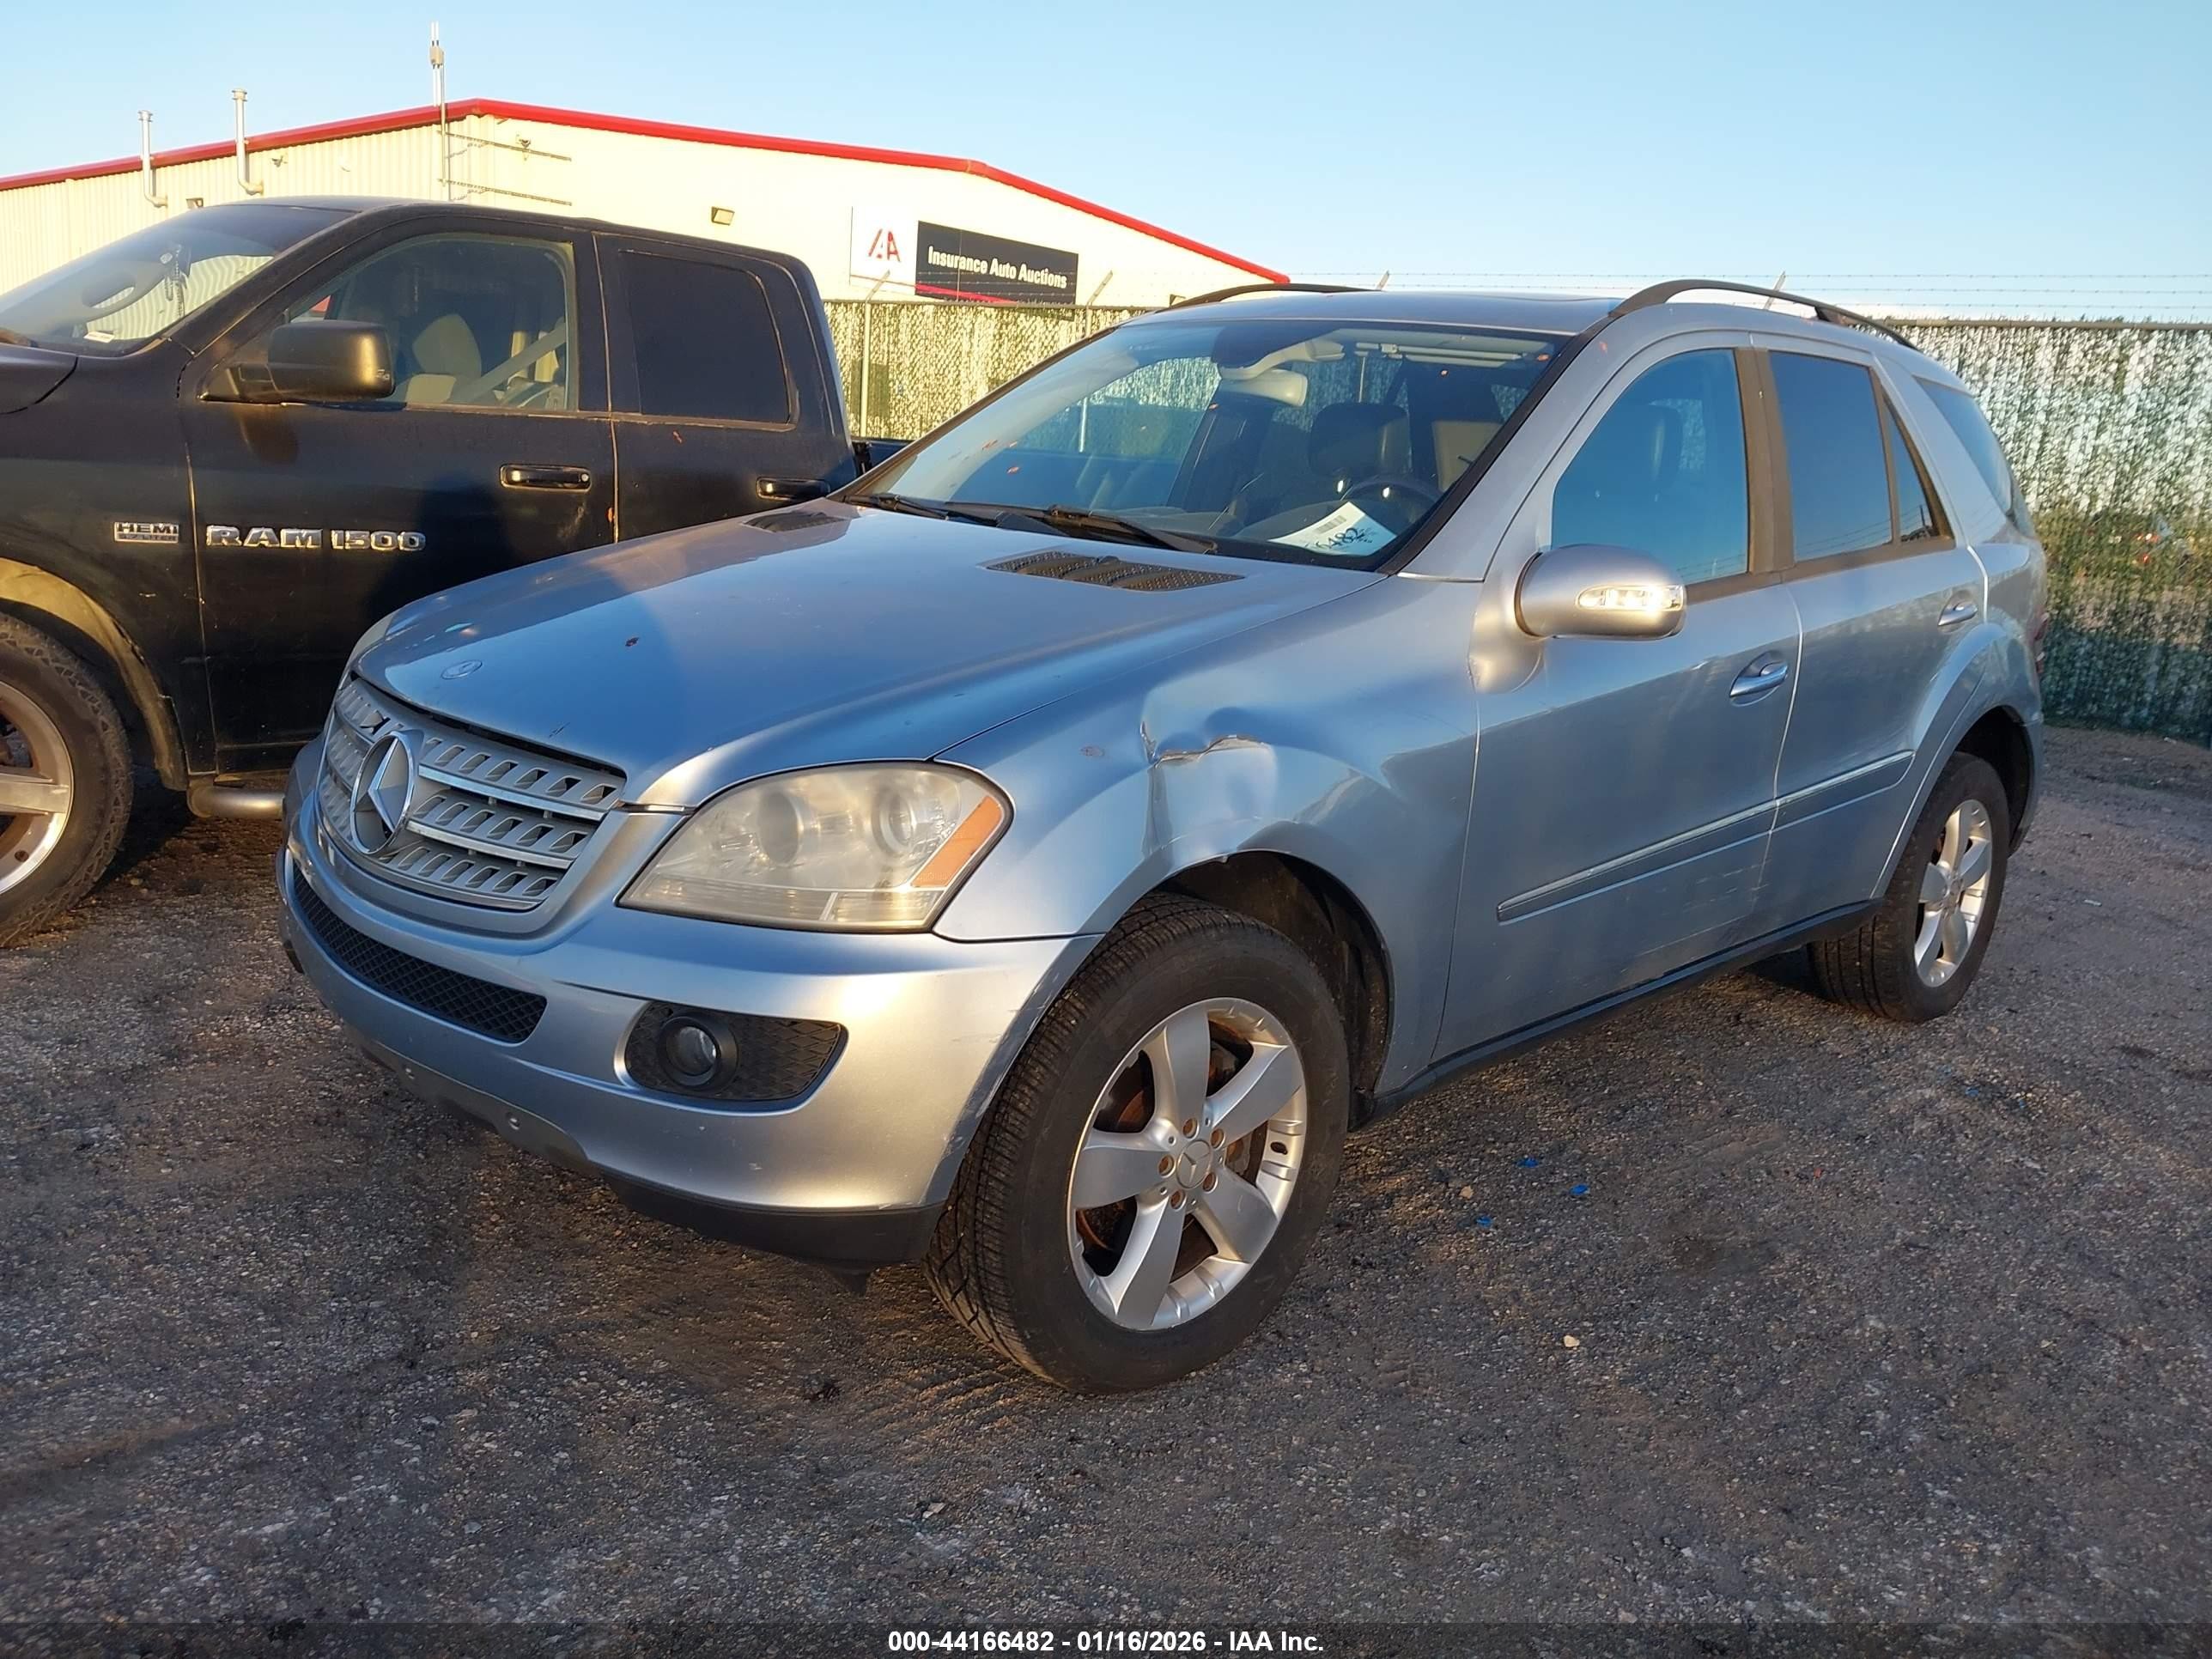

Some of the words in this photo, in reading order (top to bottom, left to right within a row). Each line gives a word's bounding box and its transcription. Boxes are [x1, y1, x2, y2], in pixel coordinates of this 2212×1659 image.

[927, 246, 988, 274] Insurance
[989, 258, 1017, 279] Auto
[1018, 263, 1067, 289] Auctions
[118, 523, 179, 534] HEMI
[206, 525, 323, 548] RAM
[331, 529, 427, 551] 1500
